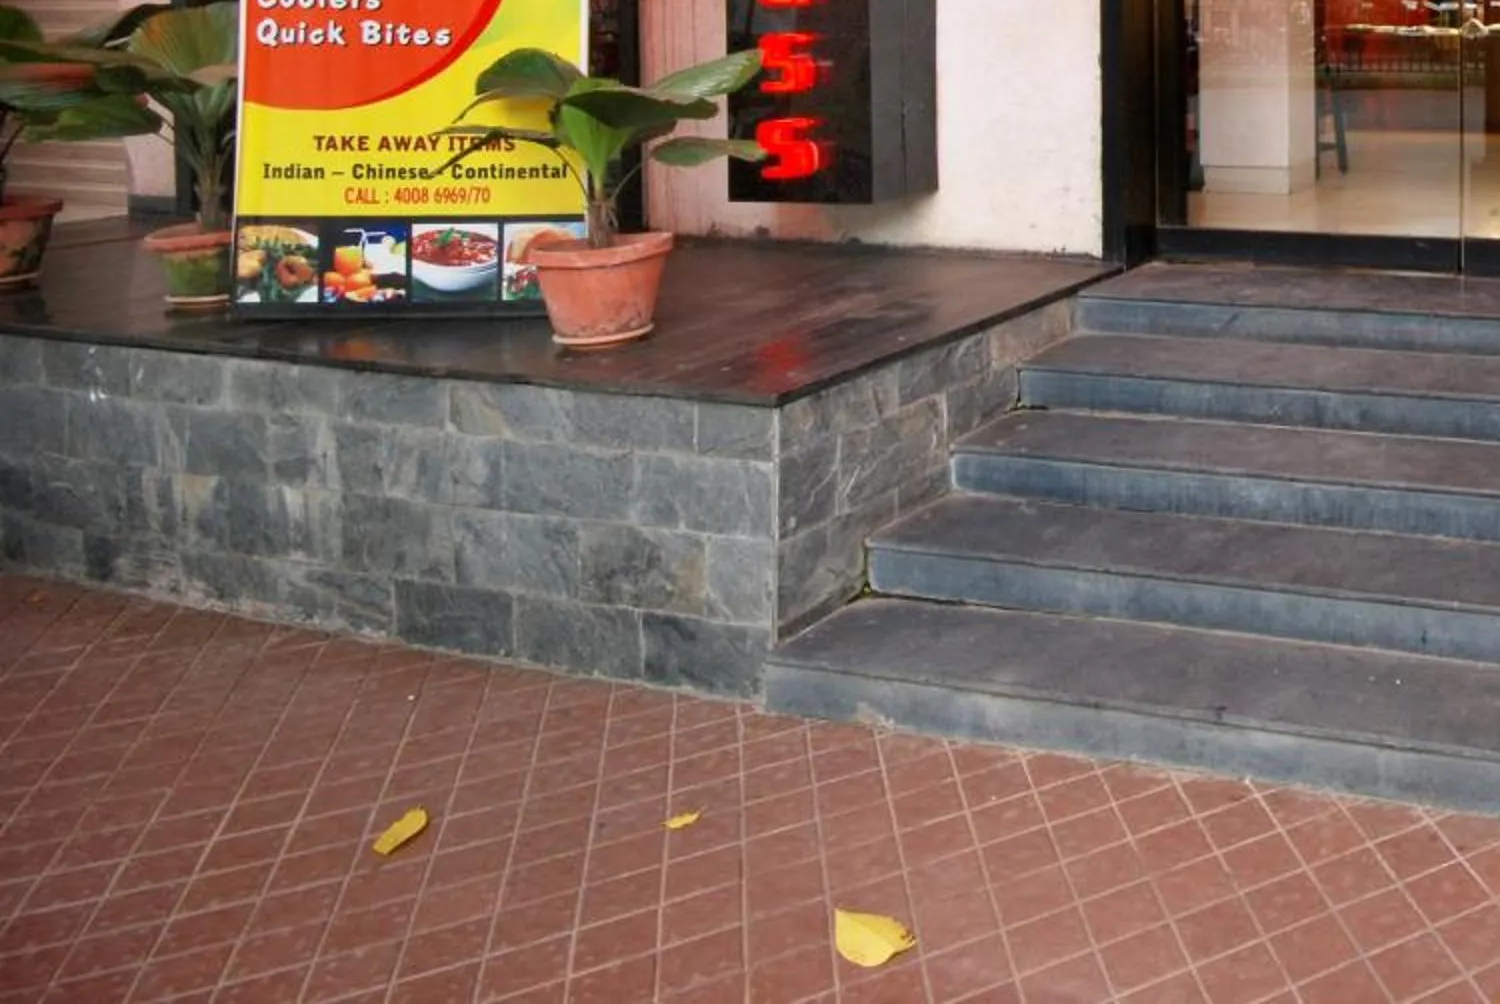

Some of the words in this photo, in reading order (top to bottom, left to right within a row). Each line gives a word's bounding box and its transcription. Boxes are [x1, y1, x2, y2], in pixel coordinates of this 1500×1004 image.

[256, 19, 346, 46] Quick
[360, 20, 454, 46] Bites
[314, 134, 369, 152] TAKE
[378, 134, 441, 152] AWAY
[263, 163, 325, 179] Indian
[352, 163, 430, 179] Chinese
[451, 163, 568, 180] Continental
[344, 186, 380, 205] CALL
[393, 186, 429, 205] 4008
[433, 186, 492, 205] 6969/70
